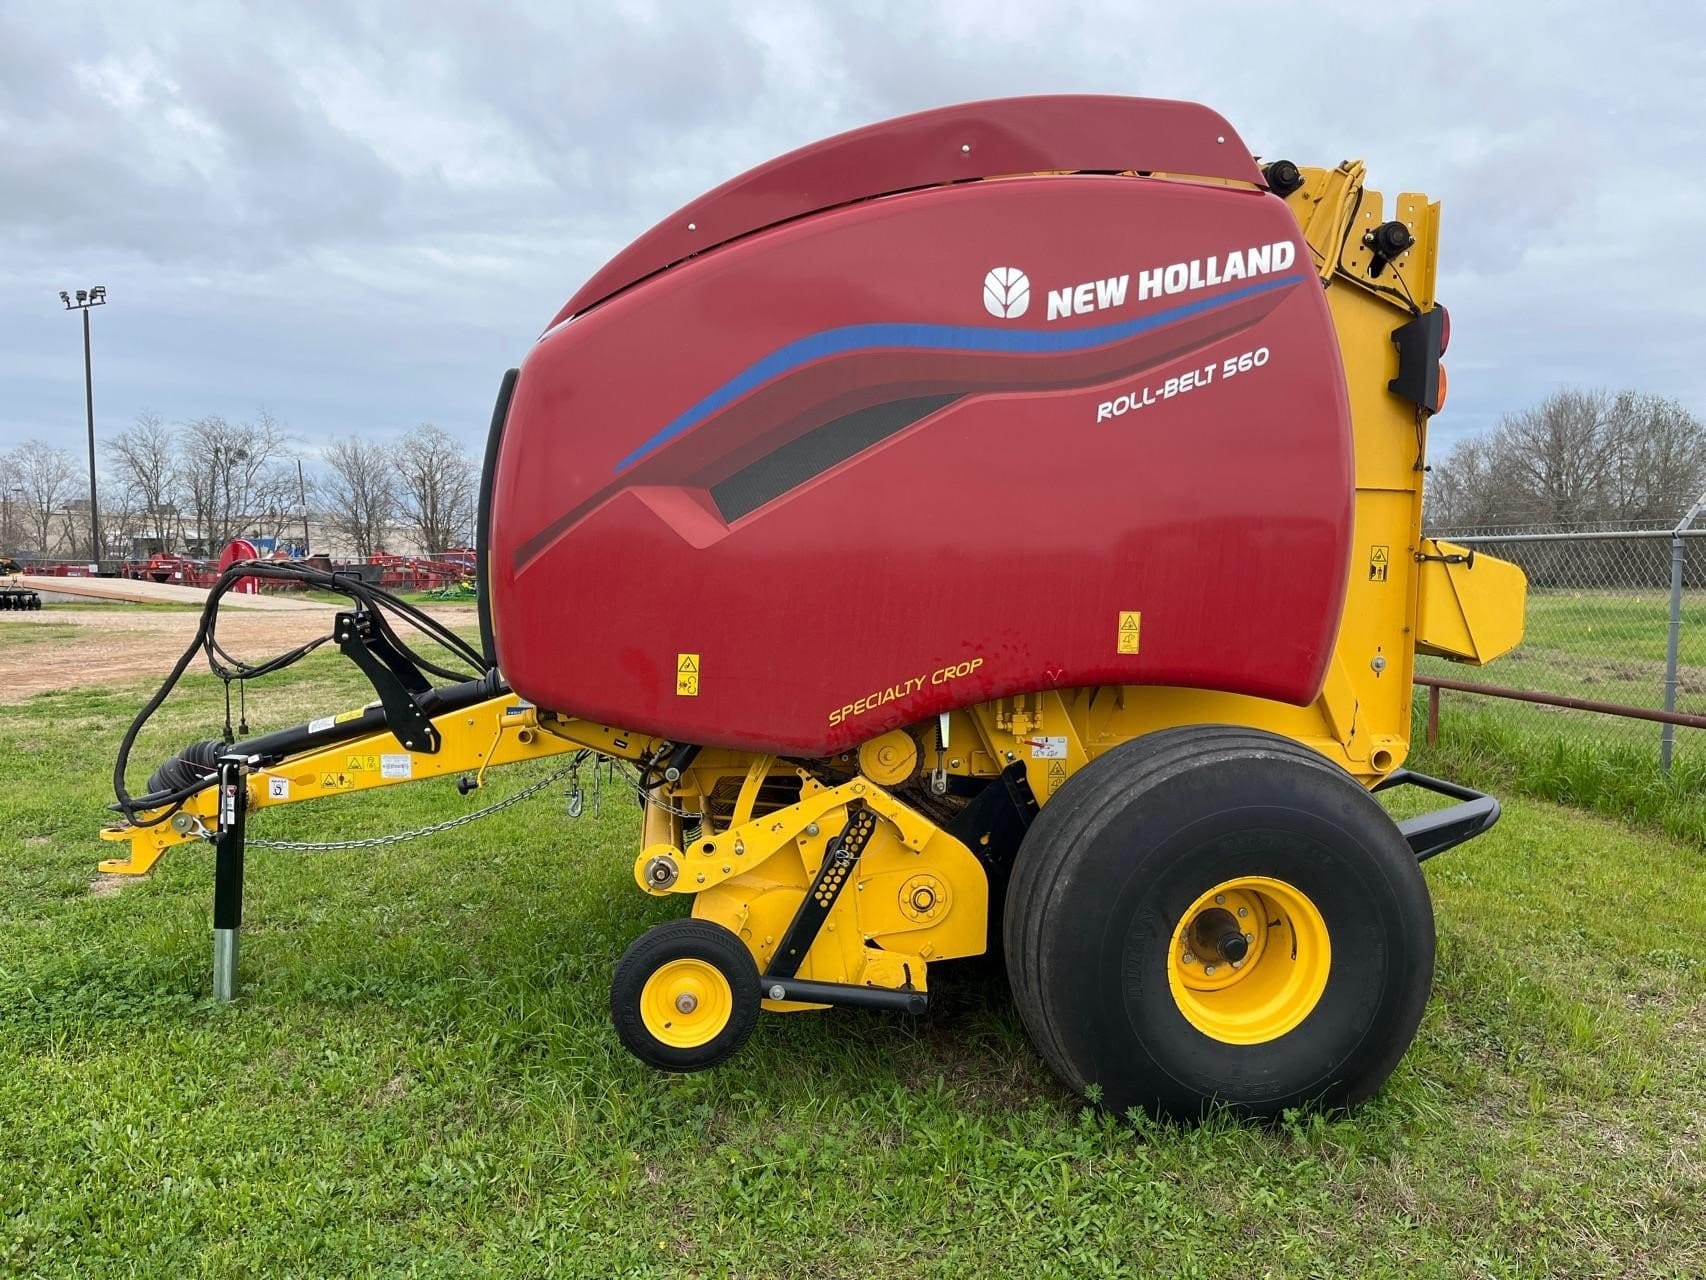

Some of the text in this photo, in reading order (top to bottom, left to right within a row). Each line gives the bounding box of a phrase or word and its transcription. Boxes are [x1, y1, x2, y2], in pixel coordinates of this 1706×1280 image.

[1046, 240, 1296, 320] NEW HOLLAND
[1096, 347, 1269, 423] ROLL-BELT 560
[829, 658, 983, 727] SPECIALTY CROP
